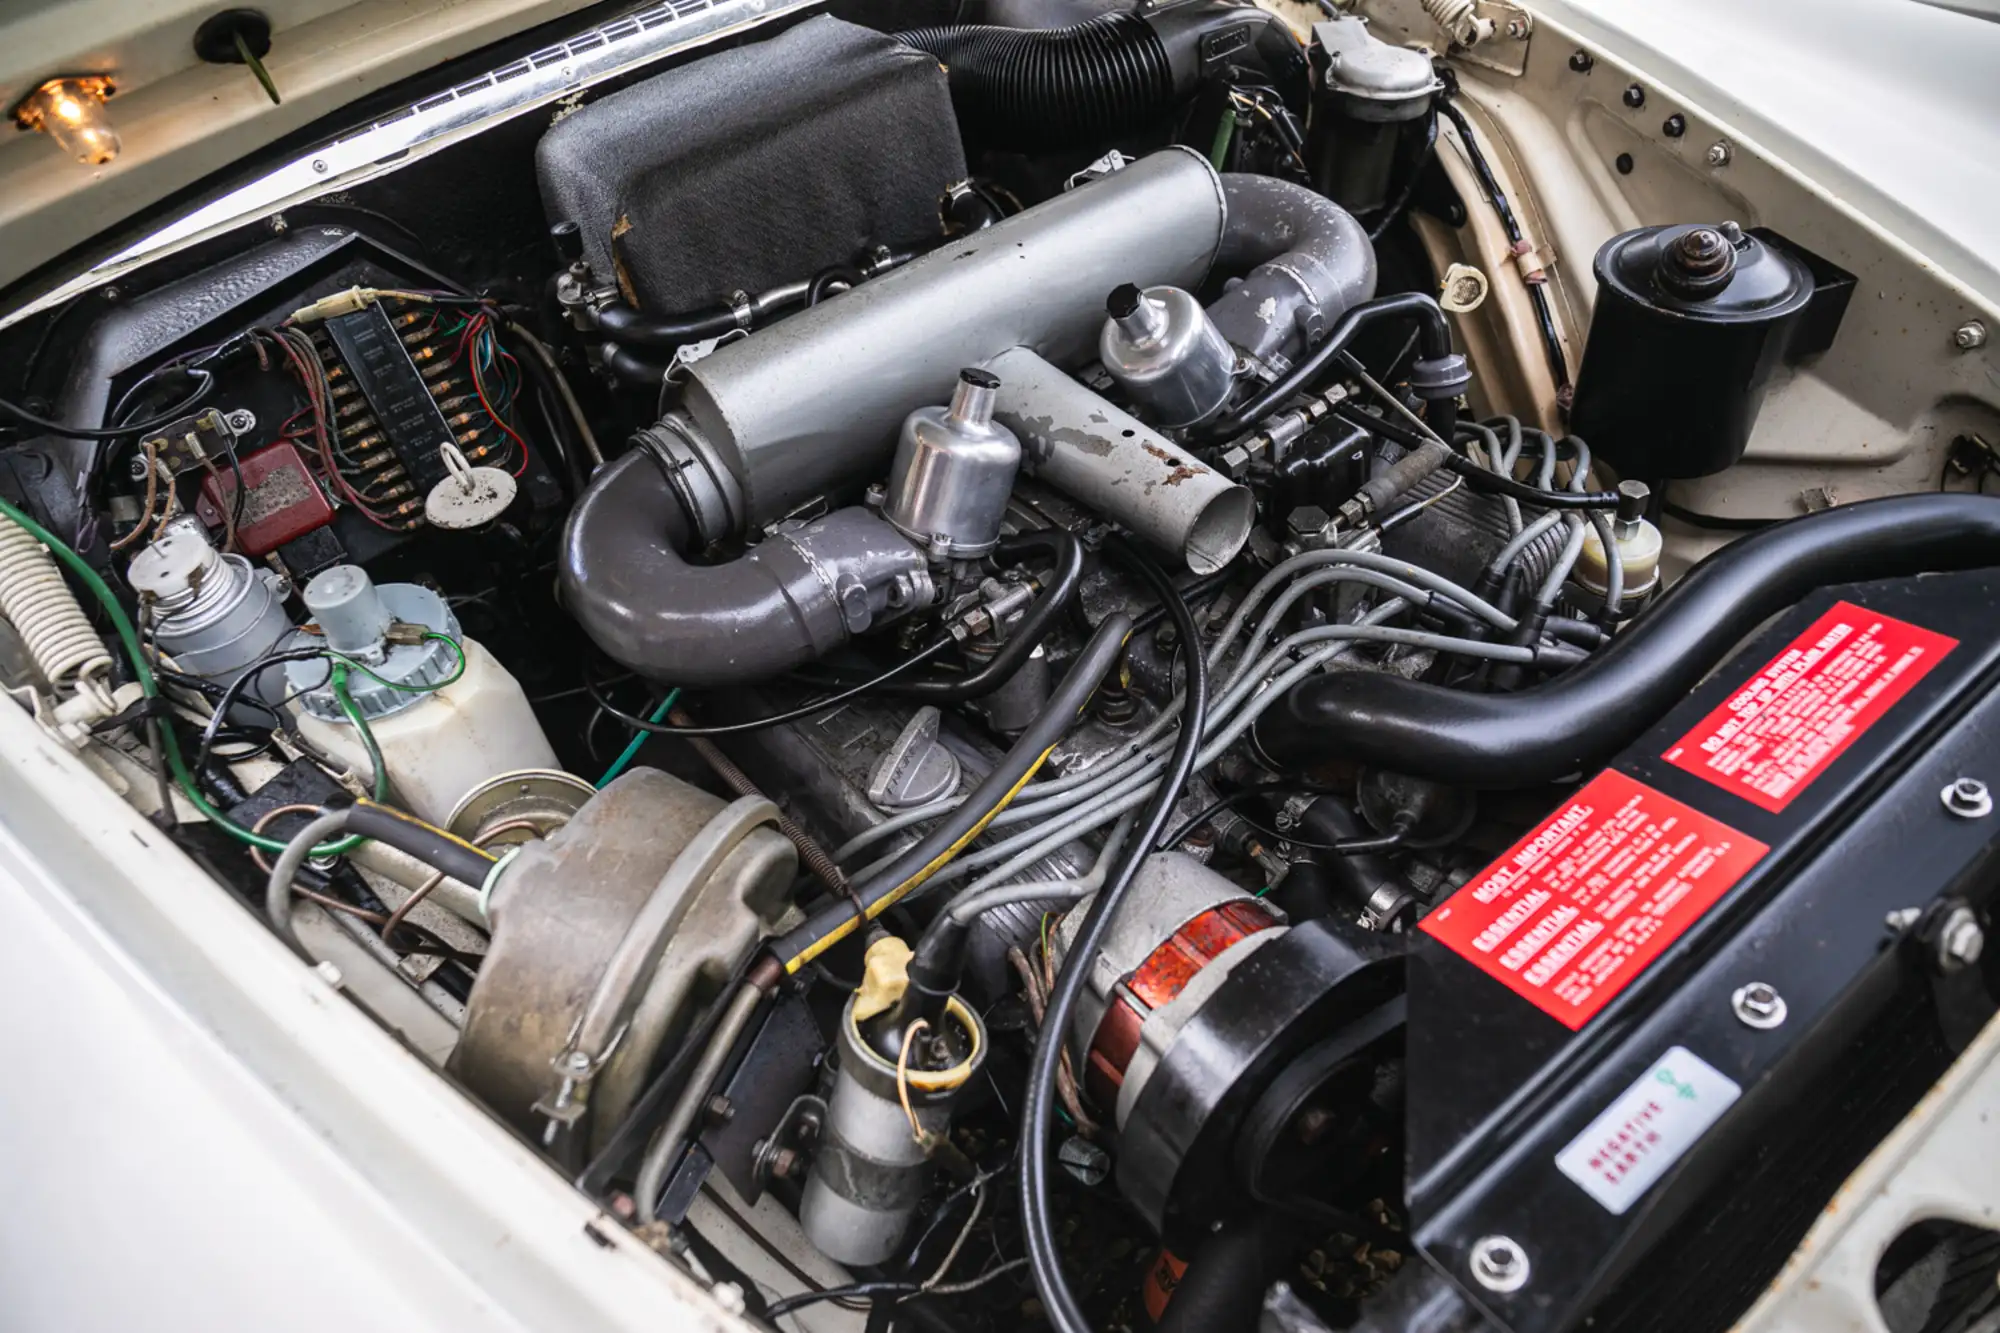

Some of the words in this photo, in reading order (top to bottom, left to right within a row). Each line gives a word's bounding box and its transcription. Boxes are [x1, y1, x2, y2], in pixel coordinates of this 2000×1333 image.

[1728, 677, 1771, 711] COOLING
[1472, 866, 1517, 902] MOST
[1472, 887, 1551, 951] ESSENTIAL
[1499, 903, 1579, 969] ESSENTIAL
[1523, 918, 1604, 985] ESSENTIAL
[1587, 1100, 1662, 1171] NEGATIVE
[1603, 1129, 1662, 1185] EARTH
